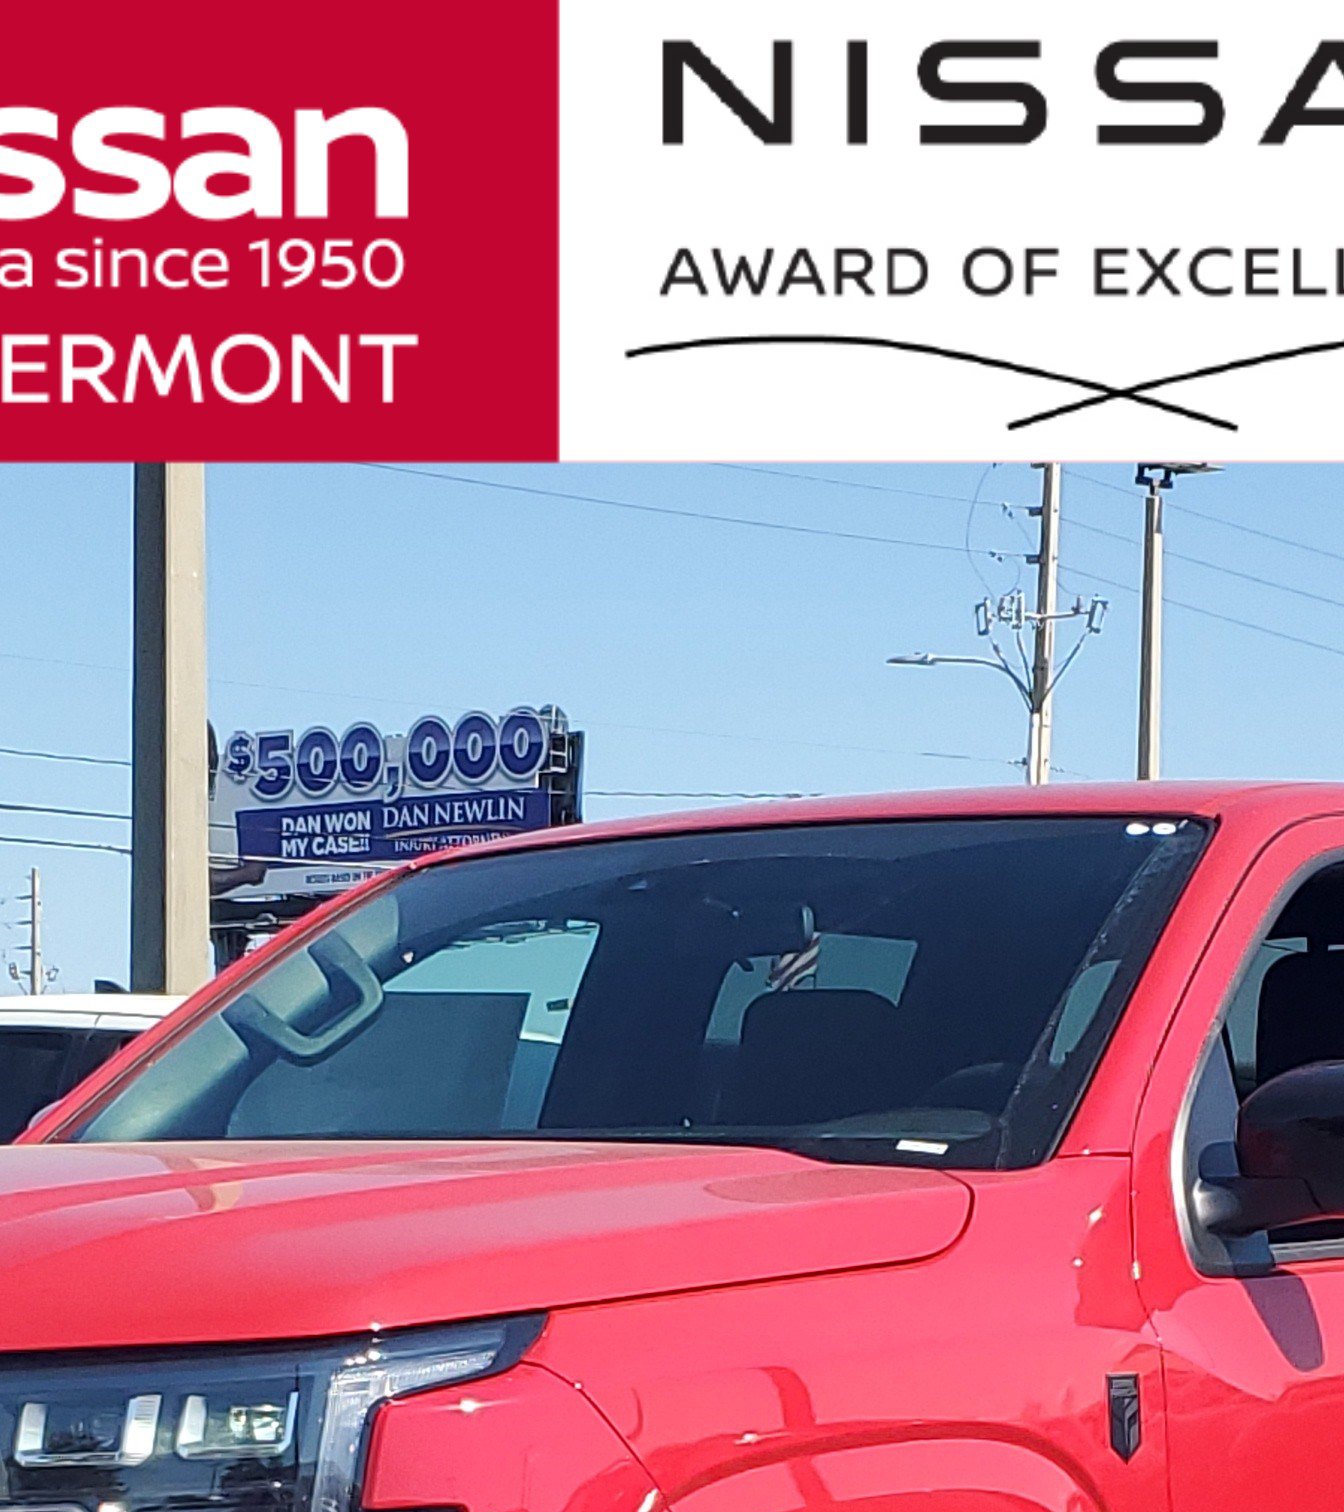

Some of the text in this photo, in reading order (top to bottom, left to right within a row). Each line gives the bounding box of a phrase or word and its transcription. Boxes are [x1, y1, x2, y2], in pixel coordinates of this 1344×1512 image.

[224, 707, 548, 804] $500,000
[282, 810, 371, 836] DAN WON
[383, 797, 525, 828] DAN NEWLIN
[281, 837, 309, 857] MY
